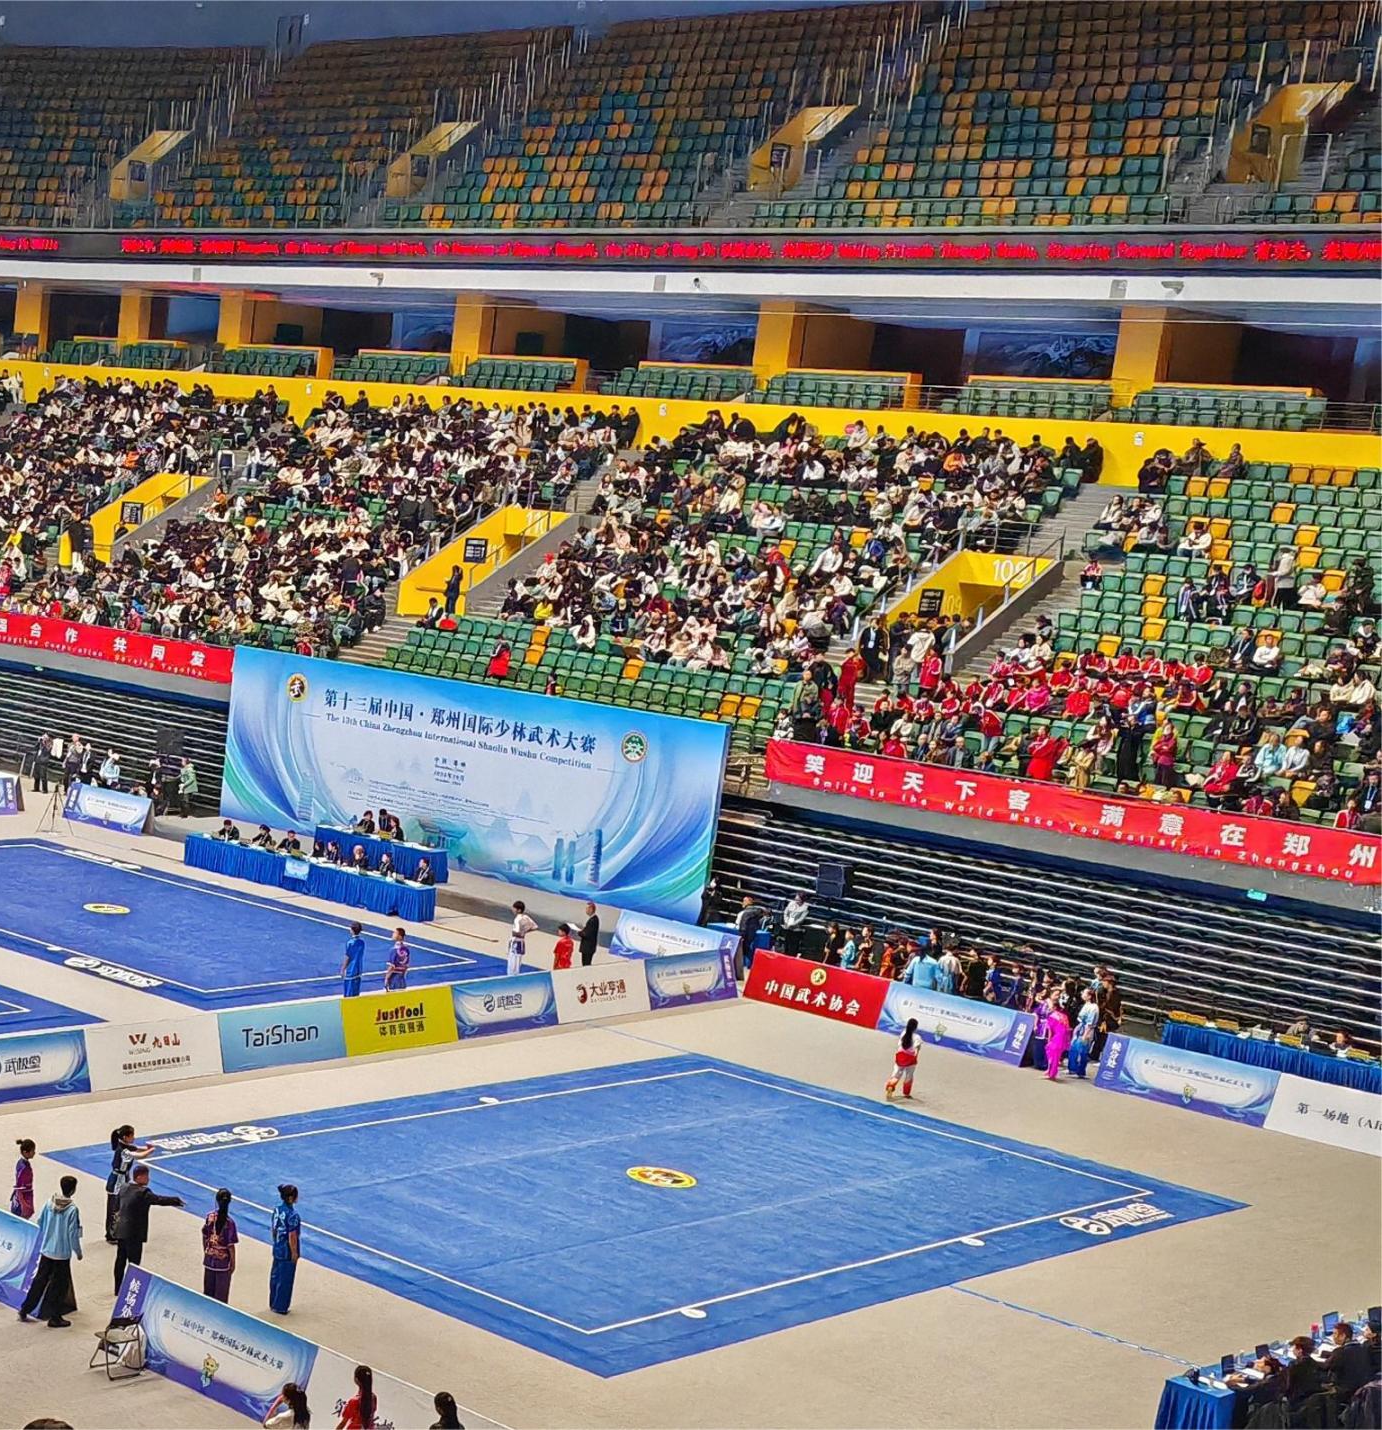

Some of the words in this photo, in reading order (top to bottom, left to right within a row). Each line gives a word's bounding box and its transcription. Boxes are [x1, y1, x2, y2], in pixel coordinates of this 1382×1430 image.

[324, 687, 597, 755] 第十三届中国·郑州国际少林武术大赛
[326, 712, 339, 721] The
[359, 718, 381, 731] China
[382, 722, 423, 738] Zhengzhou
[425, 731, 476, 749] International
[478, 741, 508, 754] Shaolin
[510, 746, 537, 760] Wushu
[539, 751, 592, 770] Competition
[813, 777, 858, 793] Smile
[869, 787, 884, 799] to
[902, 794, 927, 807] the
[944, 801, 994, 817] World
[1010, 813, 1054, 828] Make
[1068, 822, 1099, 835] You
[376, 1002, 424, 1022] JustTool
[765, 979, 862, 1017] 中国武术协会
[241, 1023, 319, 1049] TaiShan
[1298, 1102, 1349, 1126] 第一场地
